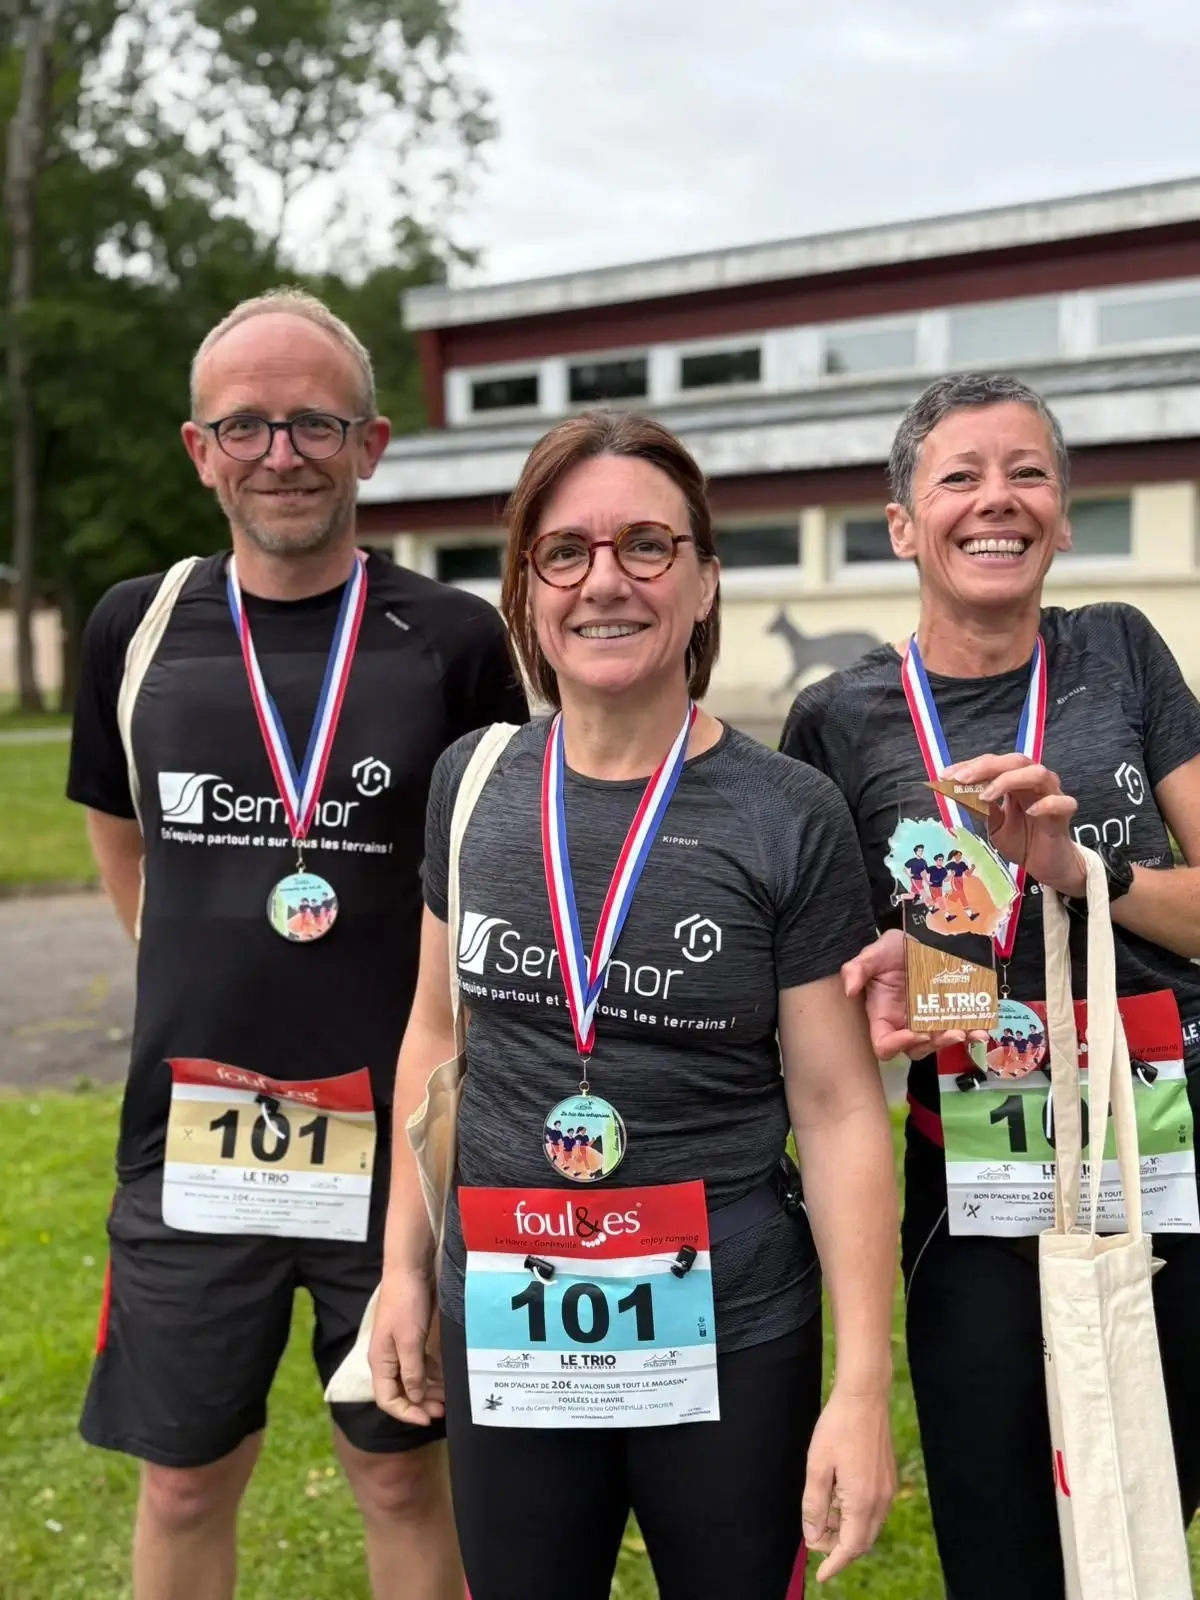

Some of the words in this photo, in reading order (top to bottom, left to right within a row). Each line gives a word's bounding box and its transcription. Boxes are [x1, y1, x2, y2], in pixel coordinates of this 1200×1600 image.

[207, 833, 249, 846] partout
[252, 834, 264, 846] et
[267, 838, 289, 847] sur
[292, 838, 317, 850] tous
[321, 838, 339, 850] les
[342, 841, 387, 854] terrains
[662, 835, 698, 847] KIPRUN
[496, 930, 684, 1000] Semnor
[491, 988, 540, 1004] partout
[546, 994, 560, 1006] et
[916, 993, 940, 1009] LE
[944, 991, 992, 1008] TRIO
[634, 1008, 657, 1025] les
[663, 1016, 726, 1031] terrains
[1182, 1023, 1199, 1042] LE
[209, 1109, 328, 1165] 101
[243, 1171, 256, 1182] LE
[261, 1172, 289, 1184] TRIO
[1032, 1191, 1054, 1200] 20€
[1141, 1185, 1168, 1194] AGASIN
[640, 1235, 663, 1246] enjoy
[665, 1233, 699, 1243] running
[511, 1280, 656, 1344] 101
[560, 1354, 577, 1366] LE
[581, 1354, 616, 1366] TRIO
[551, 1380, 572, 1390] 20€
[558, 1396, 589, 1404] FOULÉES
